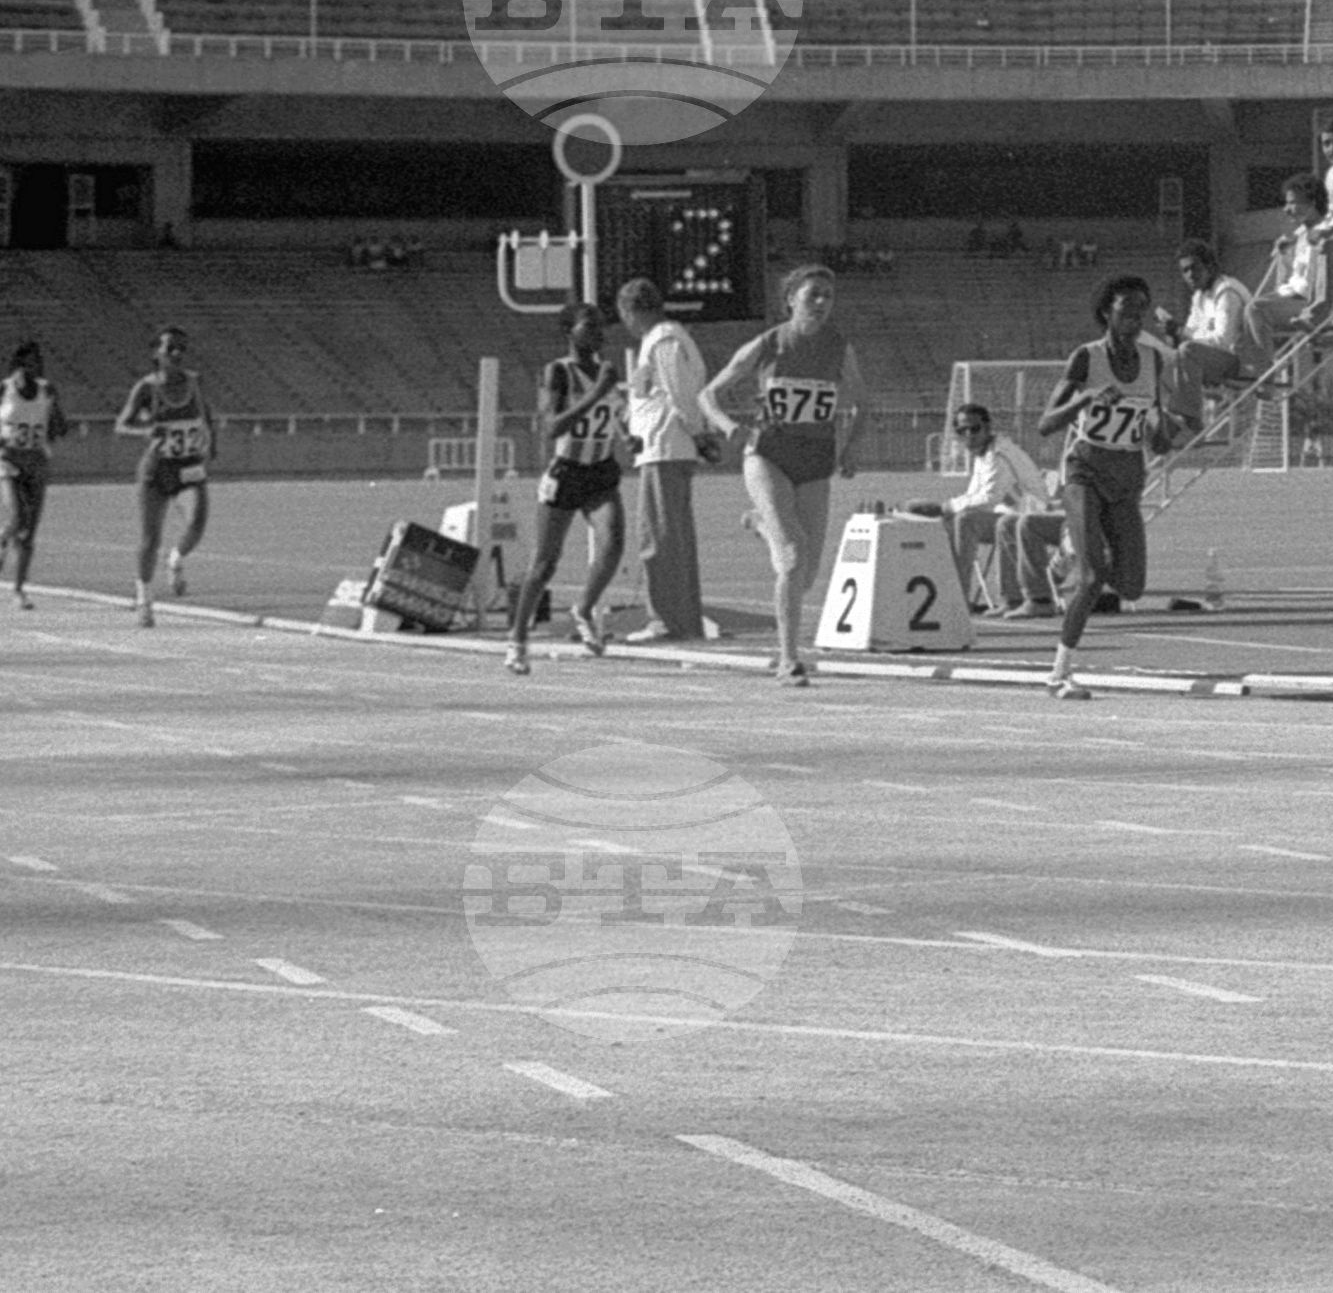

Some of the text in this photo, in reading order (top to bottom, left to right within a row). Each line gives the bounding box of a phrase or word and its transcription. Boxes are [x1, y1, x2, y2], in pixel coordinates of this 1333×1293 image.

[672, 208, 732, 291] 2
[769, 388, 835, 422] 675
[836, 578, 858, 633] 2
[906, 575, 940, 631] 2
